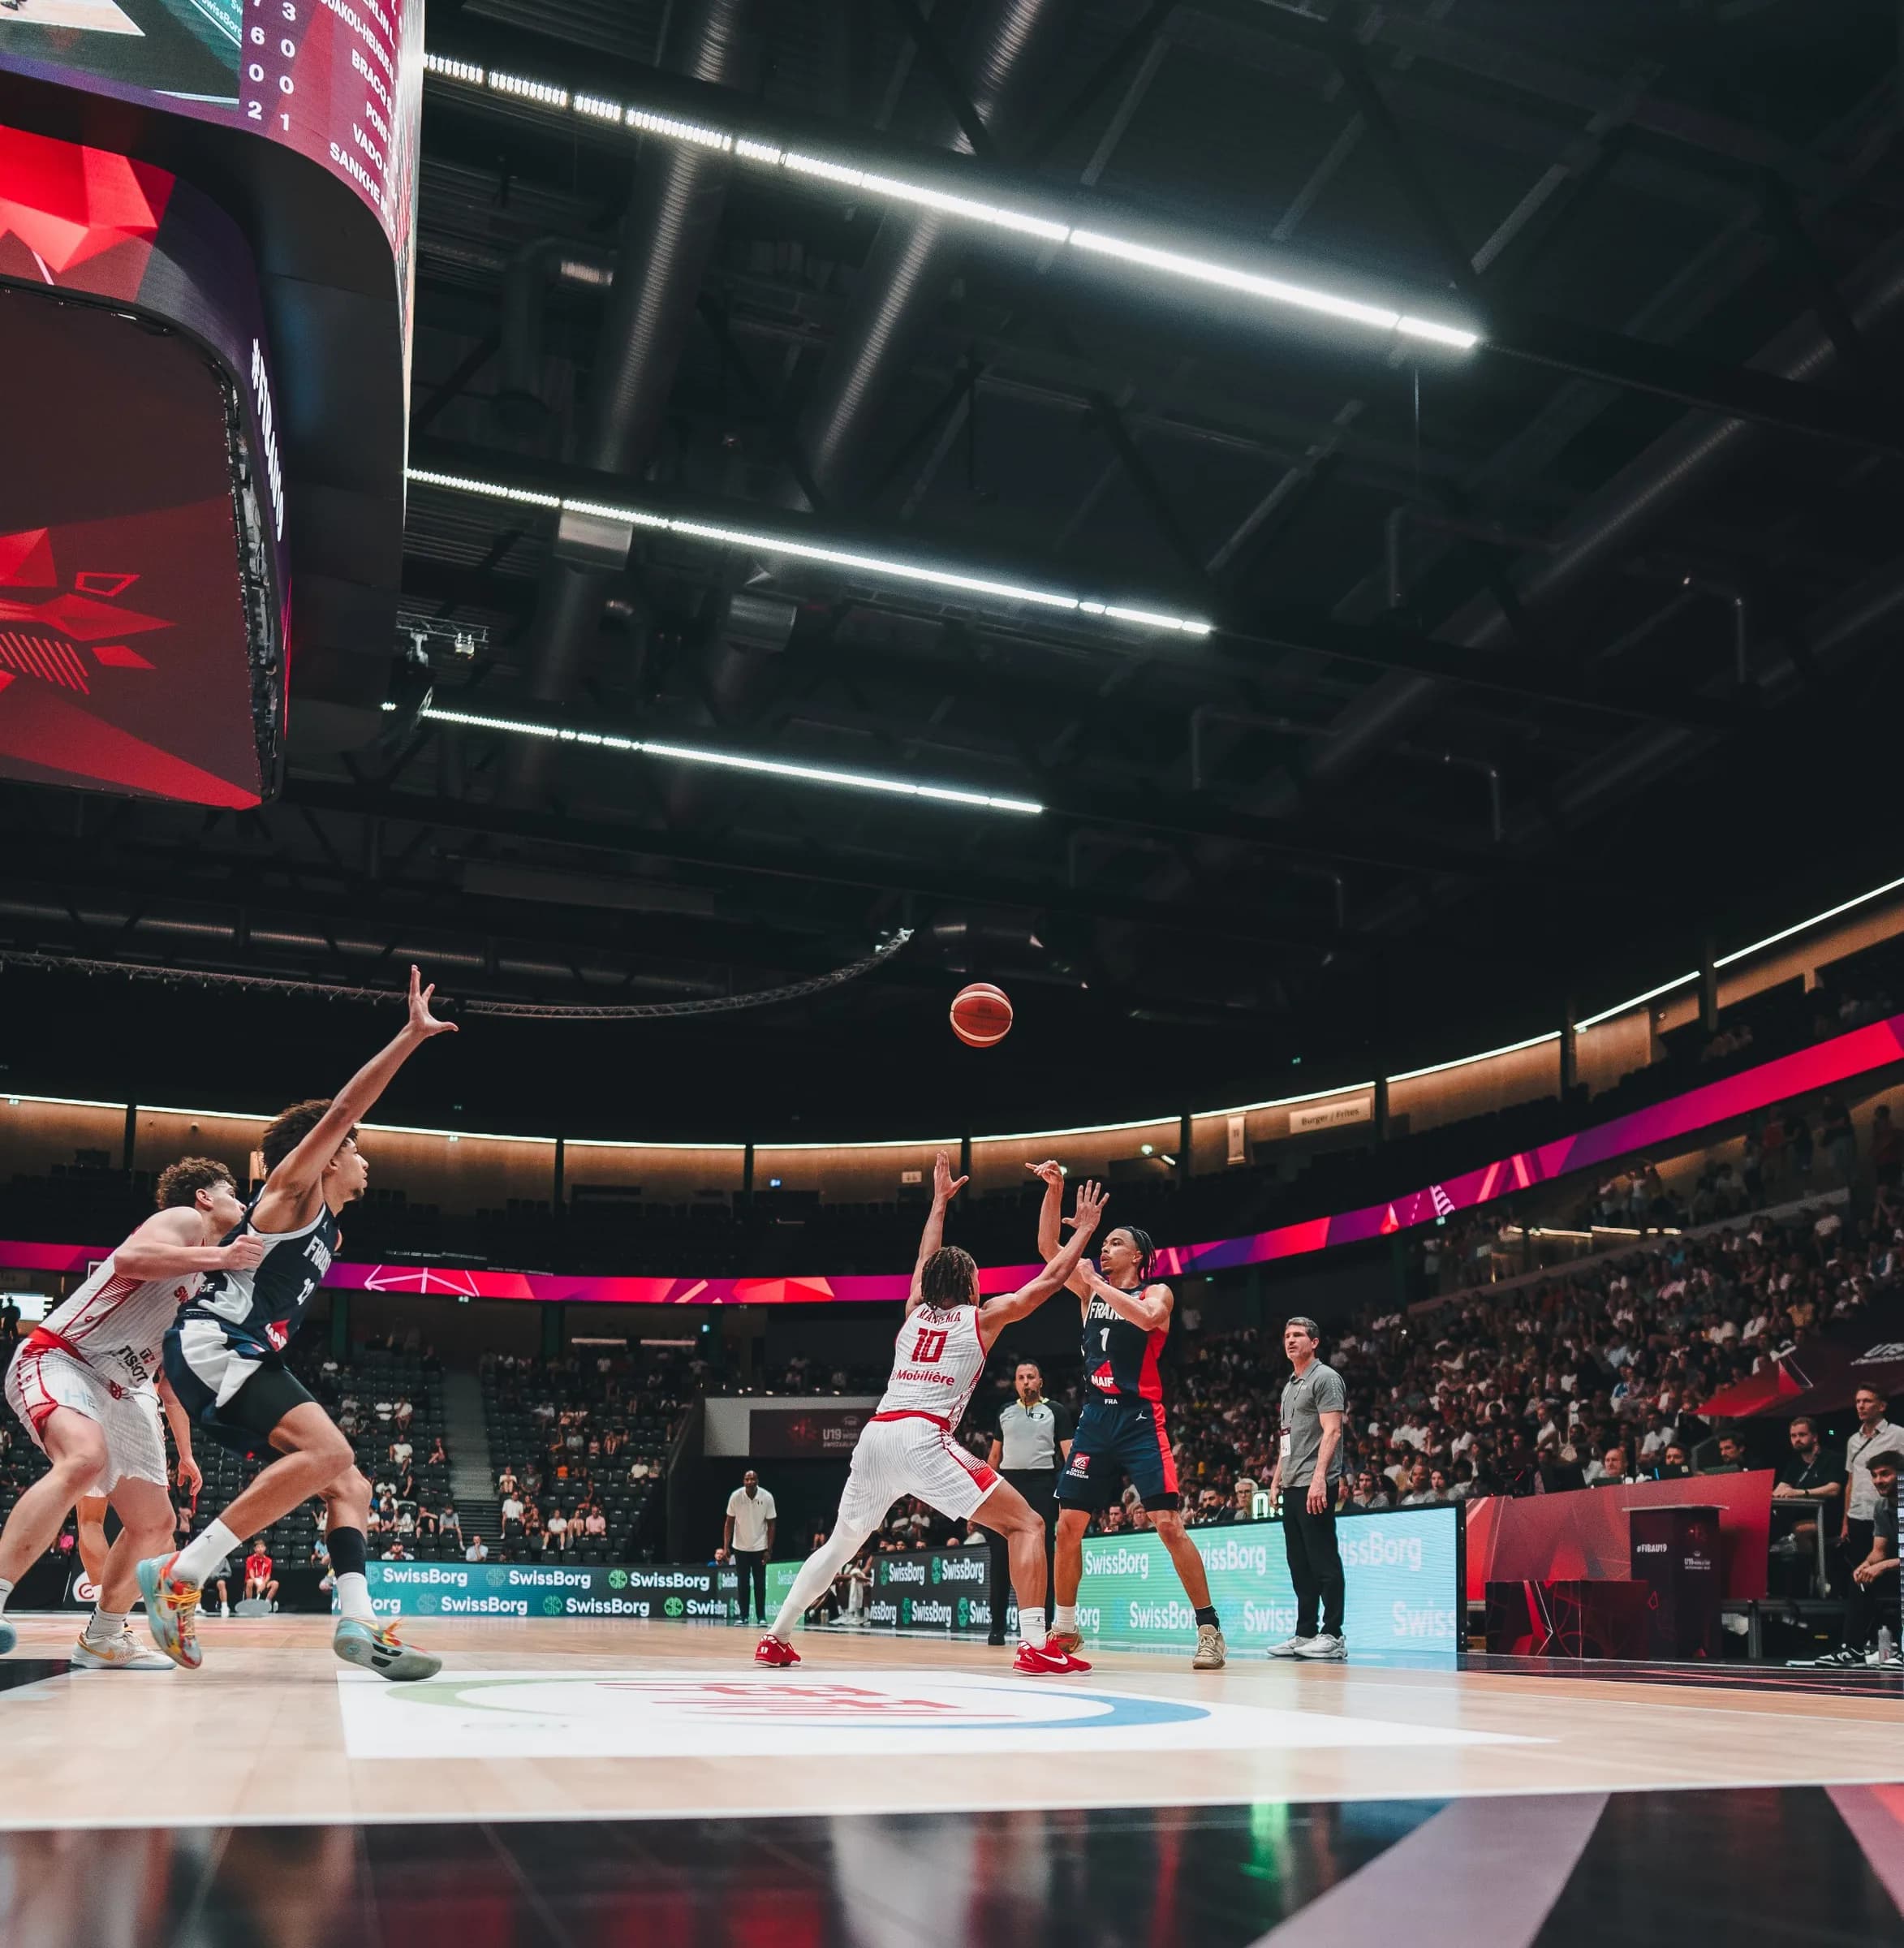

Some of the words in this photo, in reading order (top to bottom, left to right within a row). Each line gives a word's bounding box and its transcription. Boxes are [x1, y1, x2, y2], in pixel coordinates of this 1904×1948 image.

[282, 2, 296, 21] 3
[250, 26, 265, 45] 6
[280, 38, 295, 58] 0
[248, 63, 265, 82] 0
[278, 75, 295, 94] 0
[247, 101, 262, 120] 2
[280, 114, 290, 131] 1
[352, 123, 383, 170] VADO
[330, 141, 381, 205] SANKHE
[1301, 1115, 1328, 1127] Burger
[911, 1327, 949, 1363] 10
[1100, 1327, 1110, 1351] 1
[896, 1370, 955, 1386] Mobilière
[1091, 1375, 1114, 1387] MAIF
[1085, 1548, 1149, 1580] SwissBorg
[1202, 1540, 1266, 1576] issBorg
[1339, 1531, 1422, 1572] issBorg
[383, 1567, 467, 1587] SwissBorg
[509, 1570, 591, 1589] SwissBorg
[631, 1572, 710, 1591] SwissBorg
[889, 1561, 925, 1586] SwissBorg
[941, 1557, 984, 1584] SwissBorg
[441, 1596, 528, 1615] SwissBorg
[566, 1597, 650, 1617] SwissBorg
[870, 1600, 897, 1626] issBorg
[911, 1600, 952, 1628] SwissBorg
